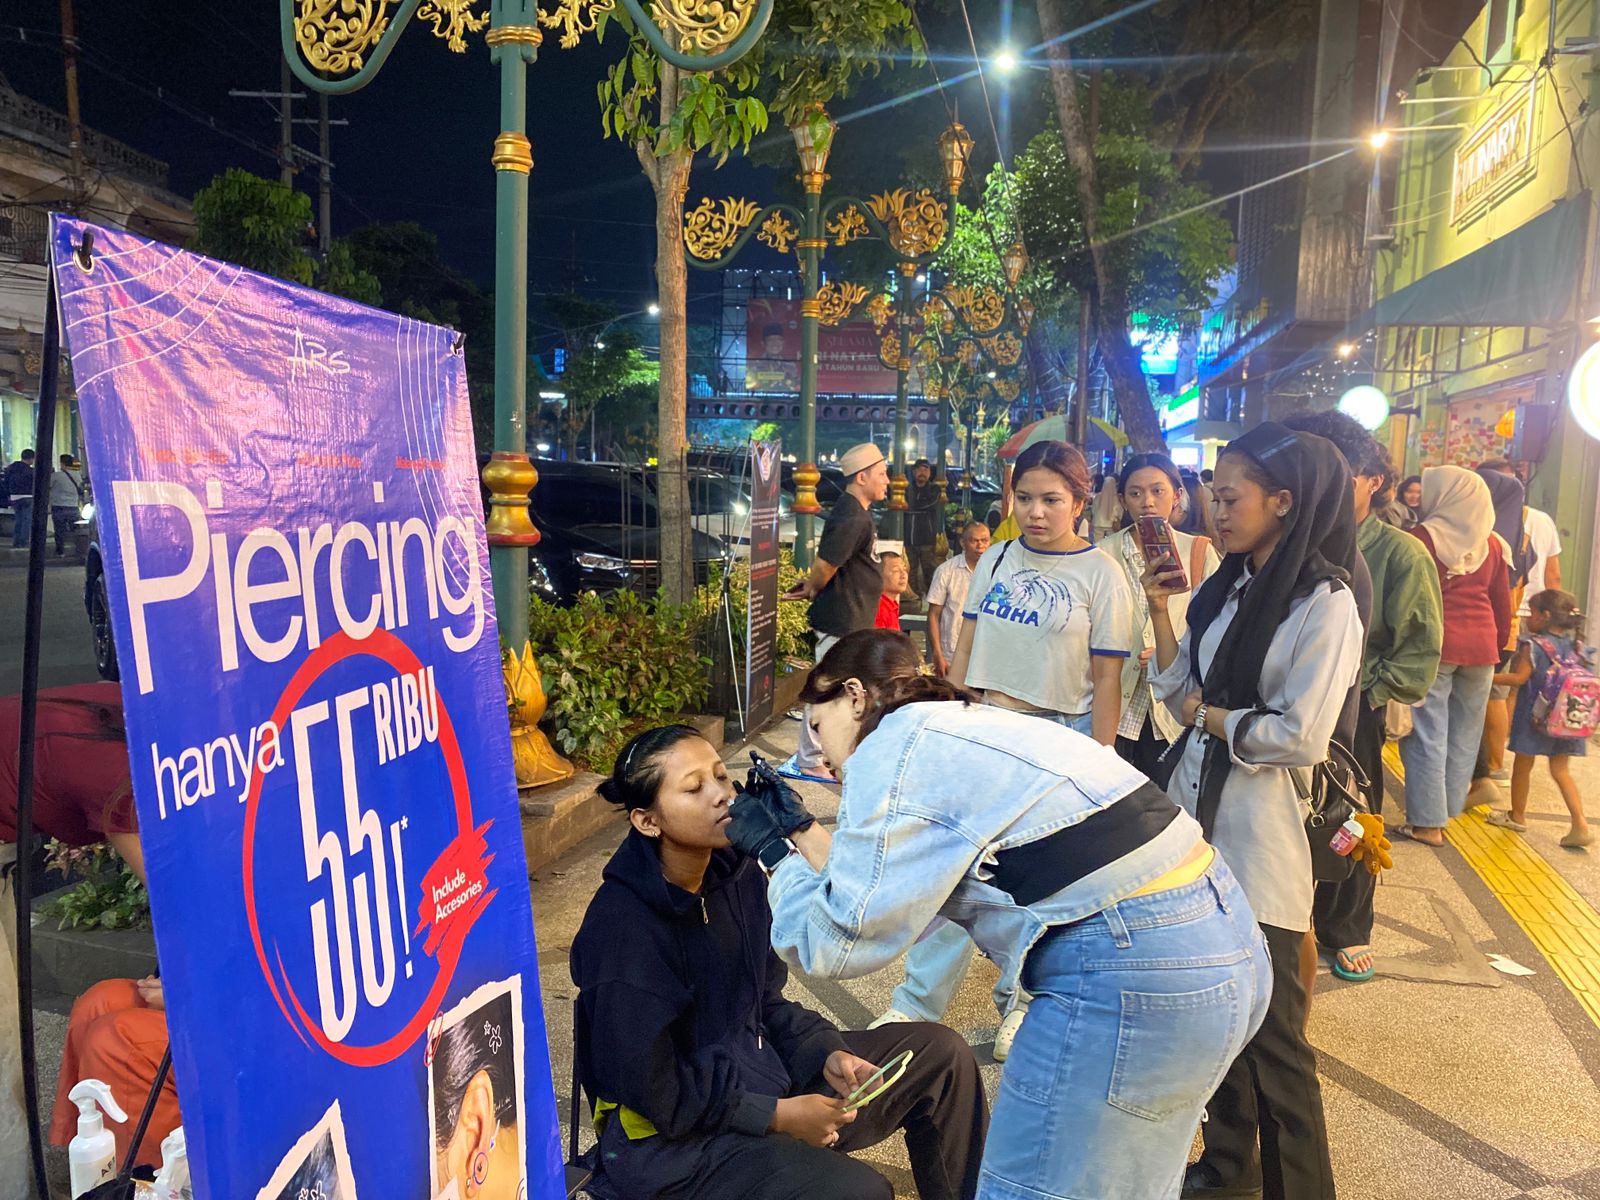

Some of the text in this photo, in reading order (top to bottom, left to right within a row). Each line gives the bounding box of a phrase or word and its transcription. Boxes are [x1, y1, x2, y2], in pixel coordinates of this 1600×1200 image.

[825, 335, 874, 349] SELAMA
[112, 481, 484, 695] Piercing
[151, 720, 285, 820] hanya
[372, 665, 439, 765] RIBU
[432, 868, 466, 905] Include
[435, 879, 482, 925] Accesories
